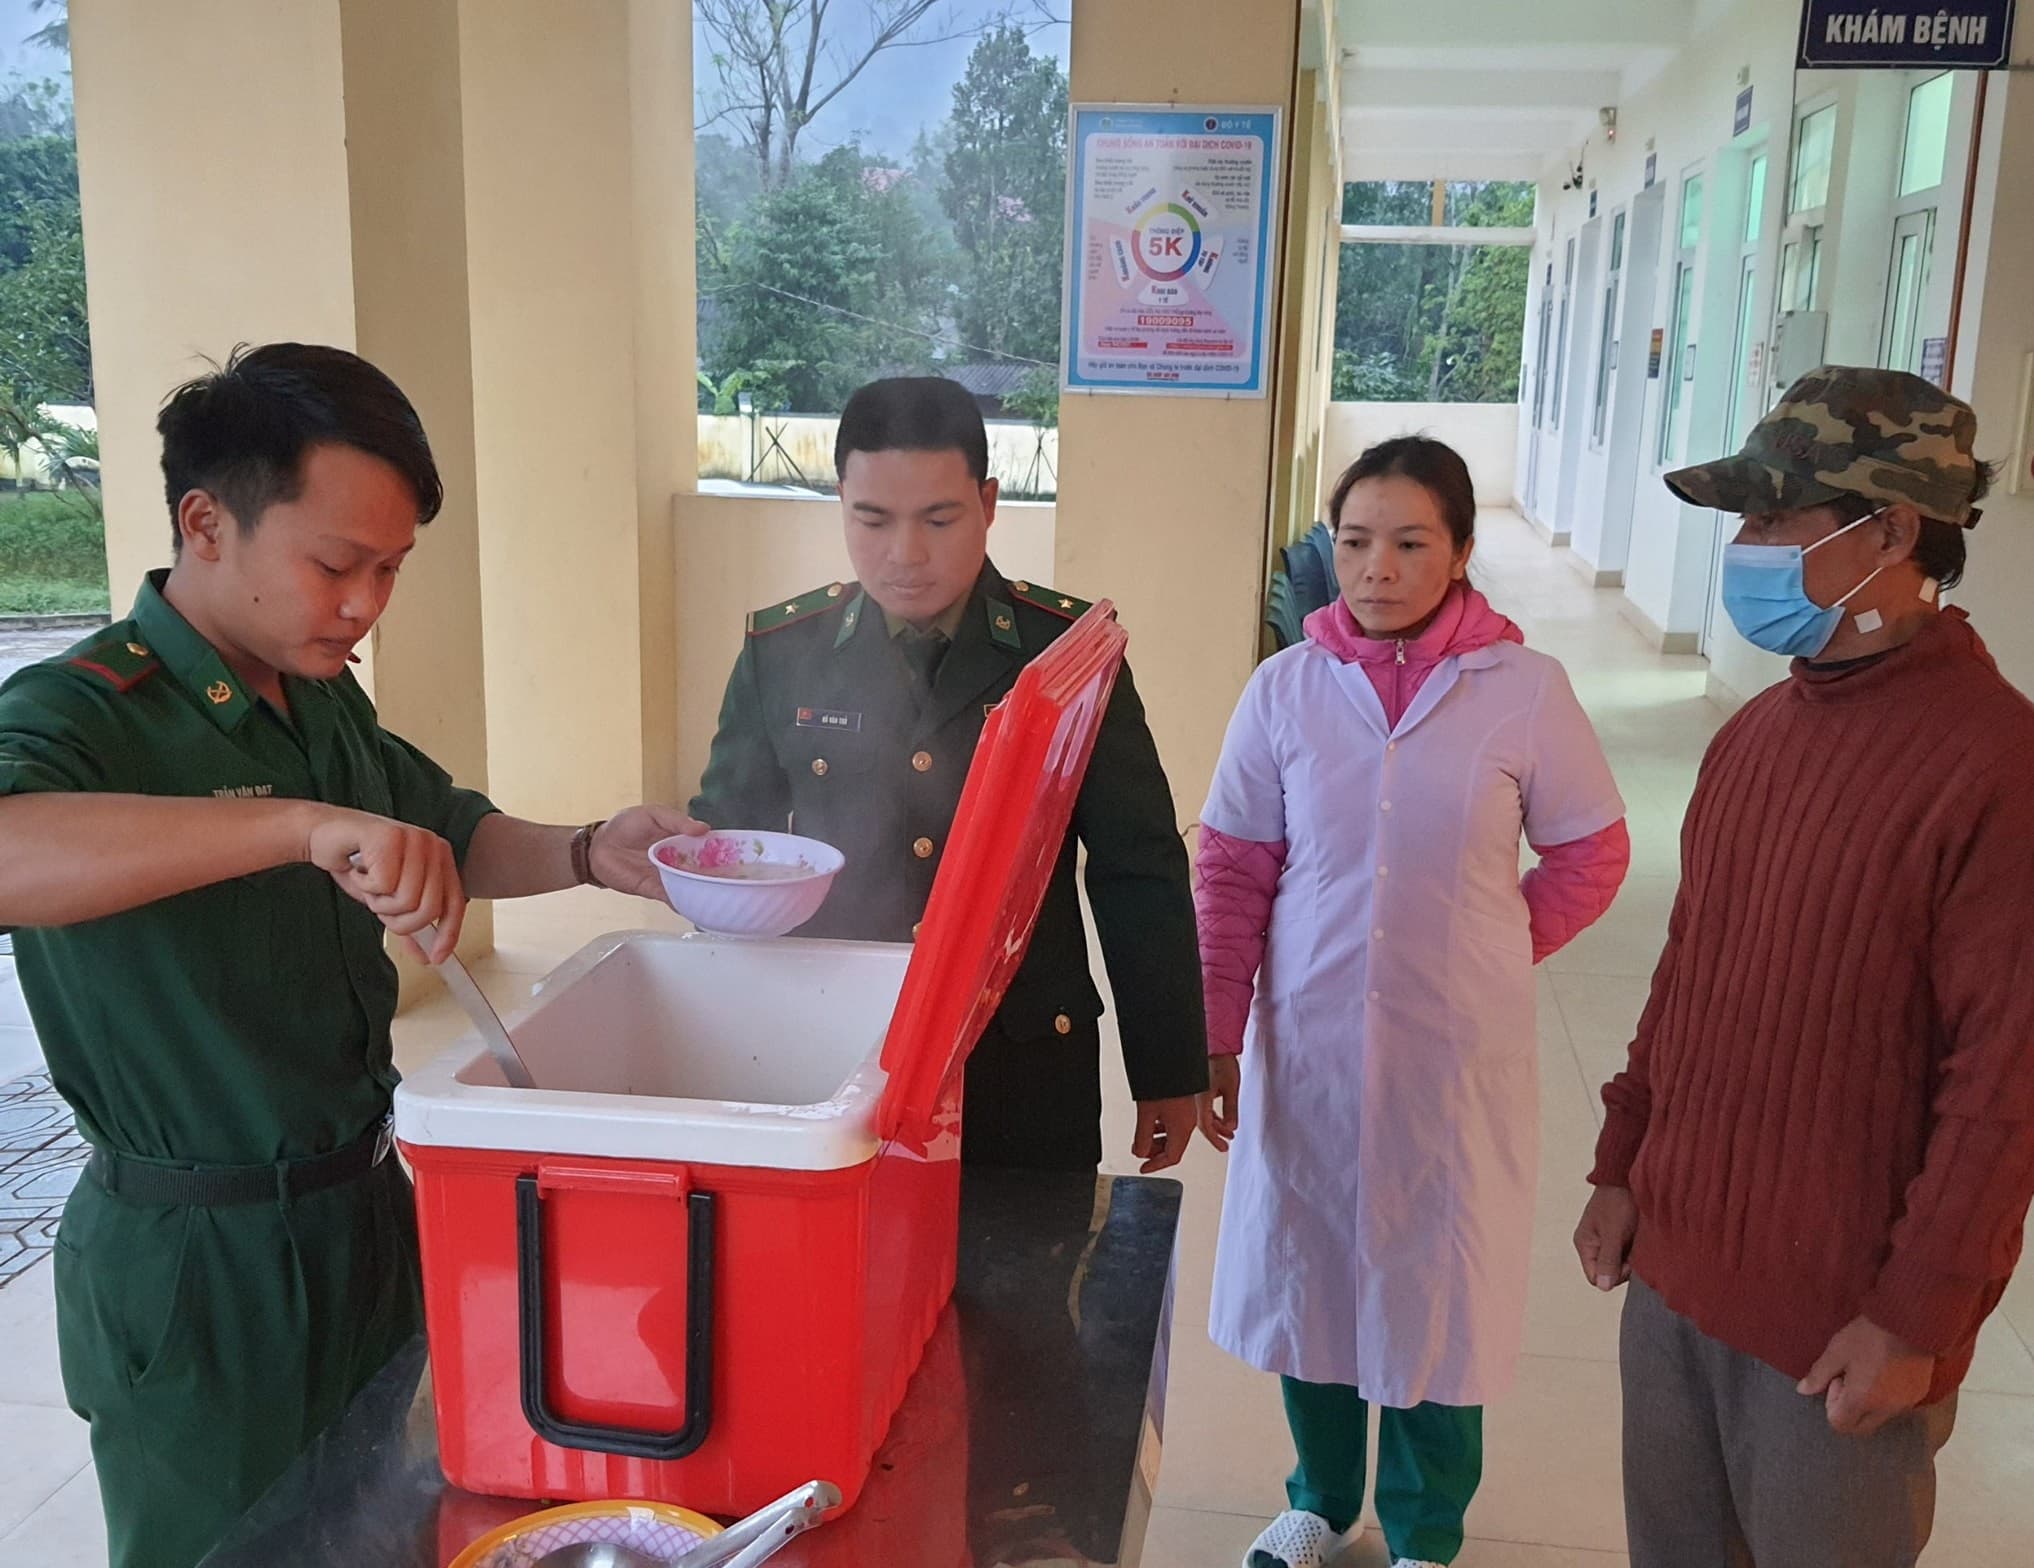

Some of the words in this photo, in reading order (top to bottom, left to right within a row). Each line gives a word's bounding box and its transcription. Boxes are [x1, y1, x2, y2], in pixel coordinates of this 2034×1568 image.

[1825, 9, 1906, 43] KHÁM
[1913, 10, 1987, 50] BỆNH
[1149, 236, 1183, 257] 5K
[1140, 316, 1192, 325] 19009095
